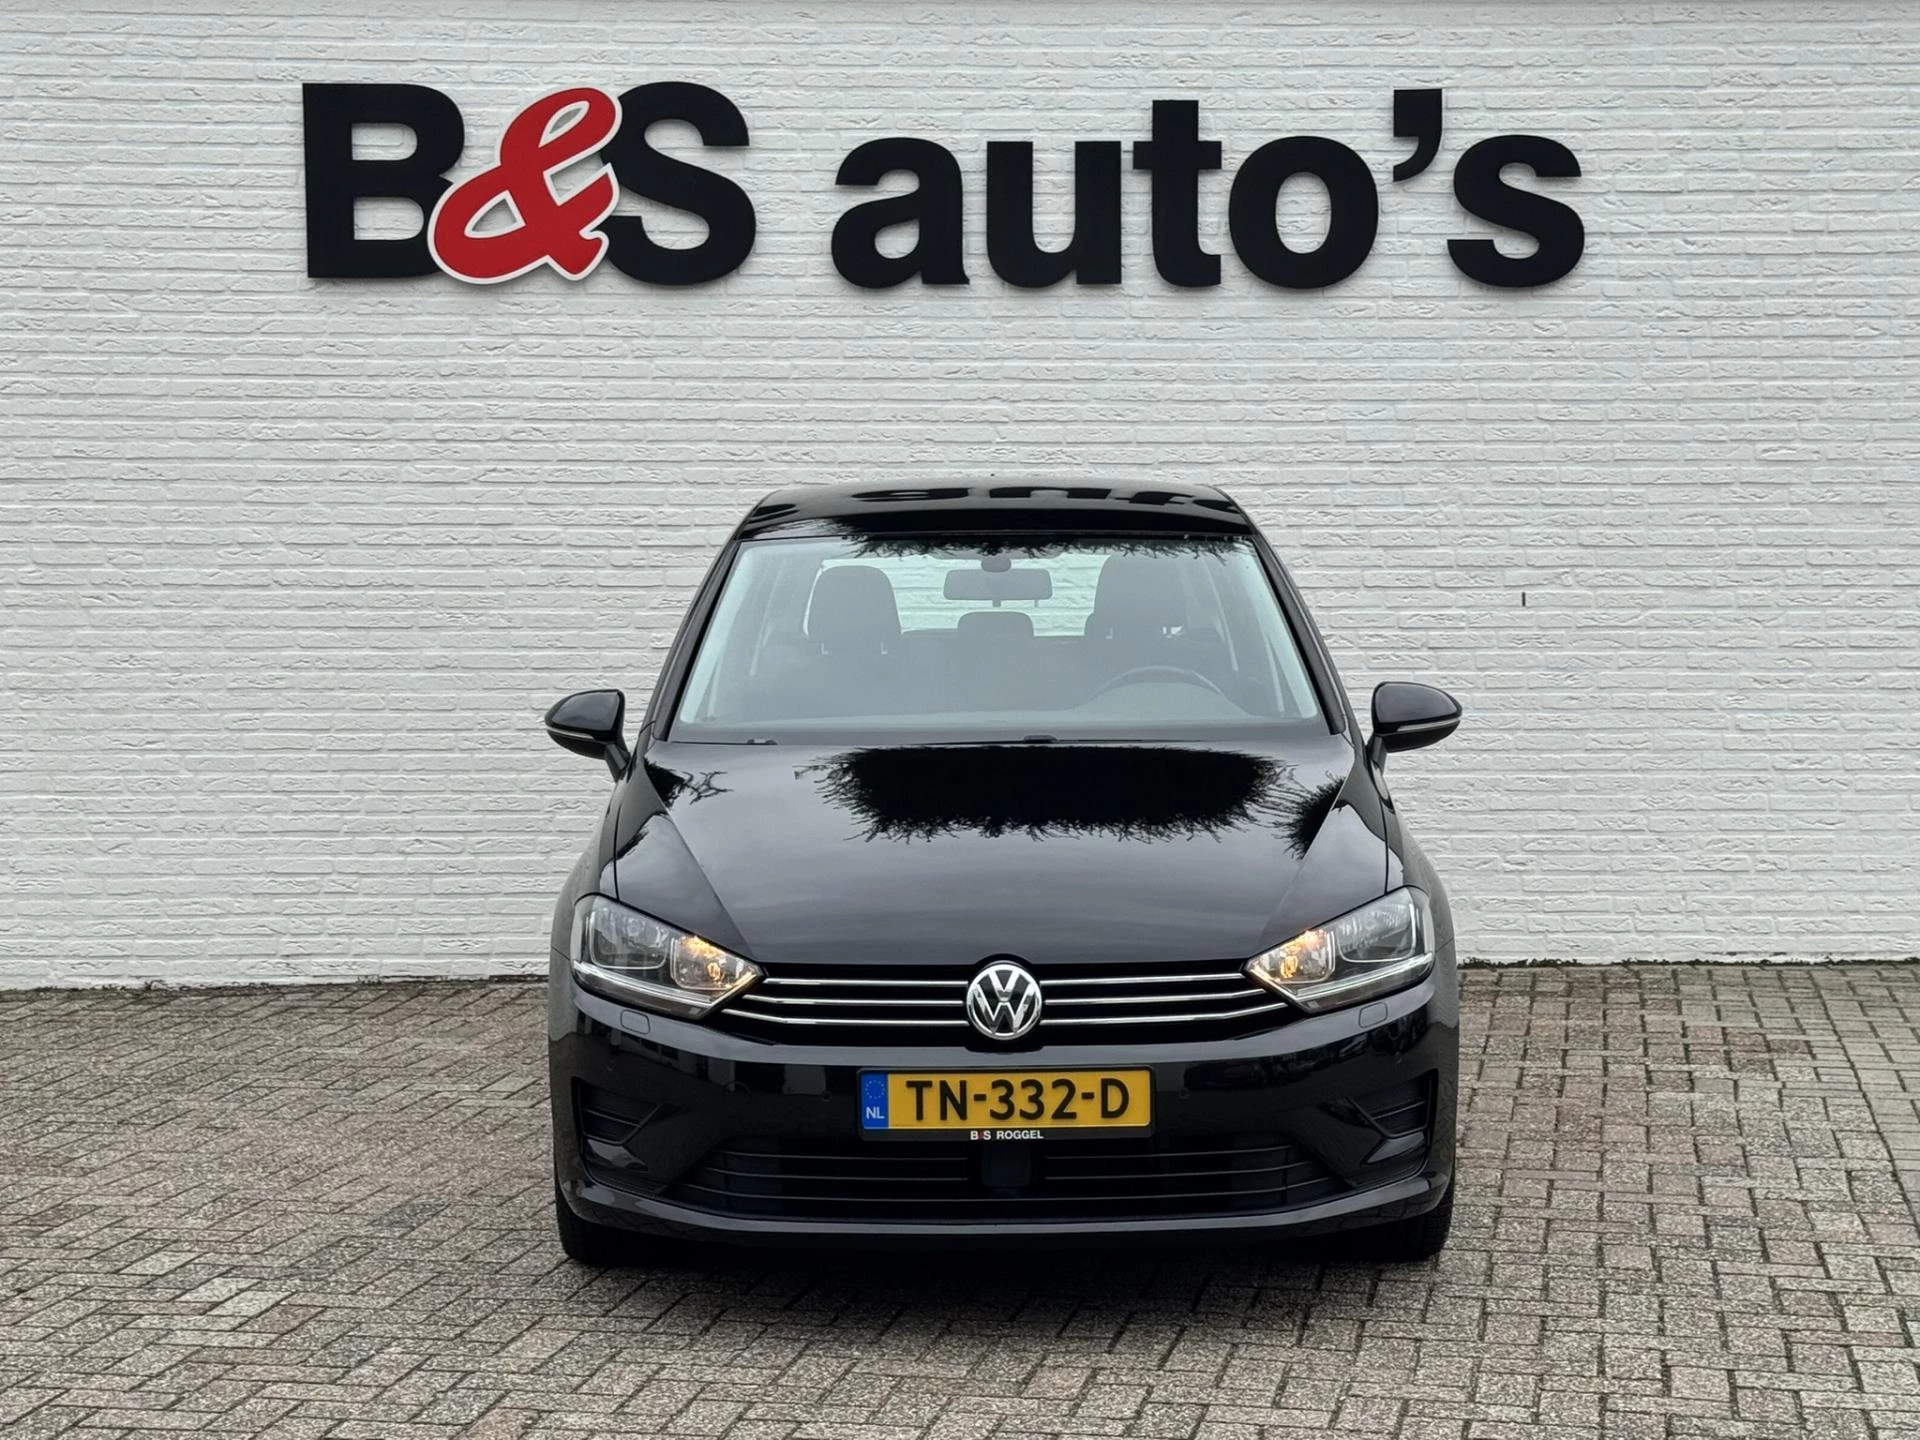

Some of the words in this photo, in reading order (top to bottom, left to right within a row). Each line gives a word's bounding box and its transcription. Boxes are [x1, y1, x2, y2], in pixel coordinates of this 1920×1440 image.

[302, 81, 757, 285] B&S
[831, 88, 1586, 289] auto's
[969, 962, 1040, 1039] VW
[865, 1106, 885, 1119] NL
[905, 1078, 1130, 1121] TN-332-D
[996, 1130, 1044, 1140] ROGGEL
